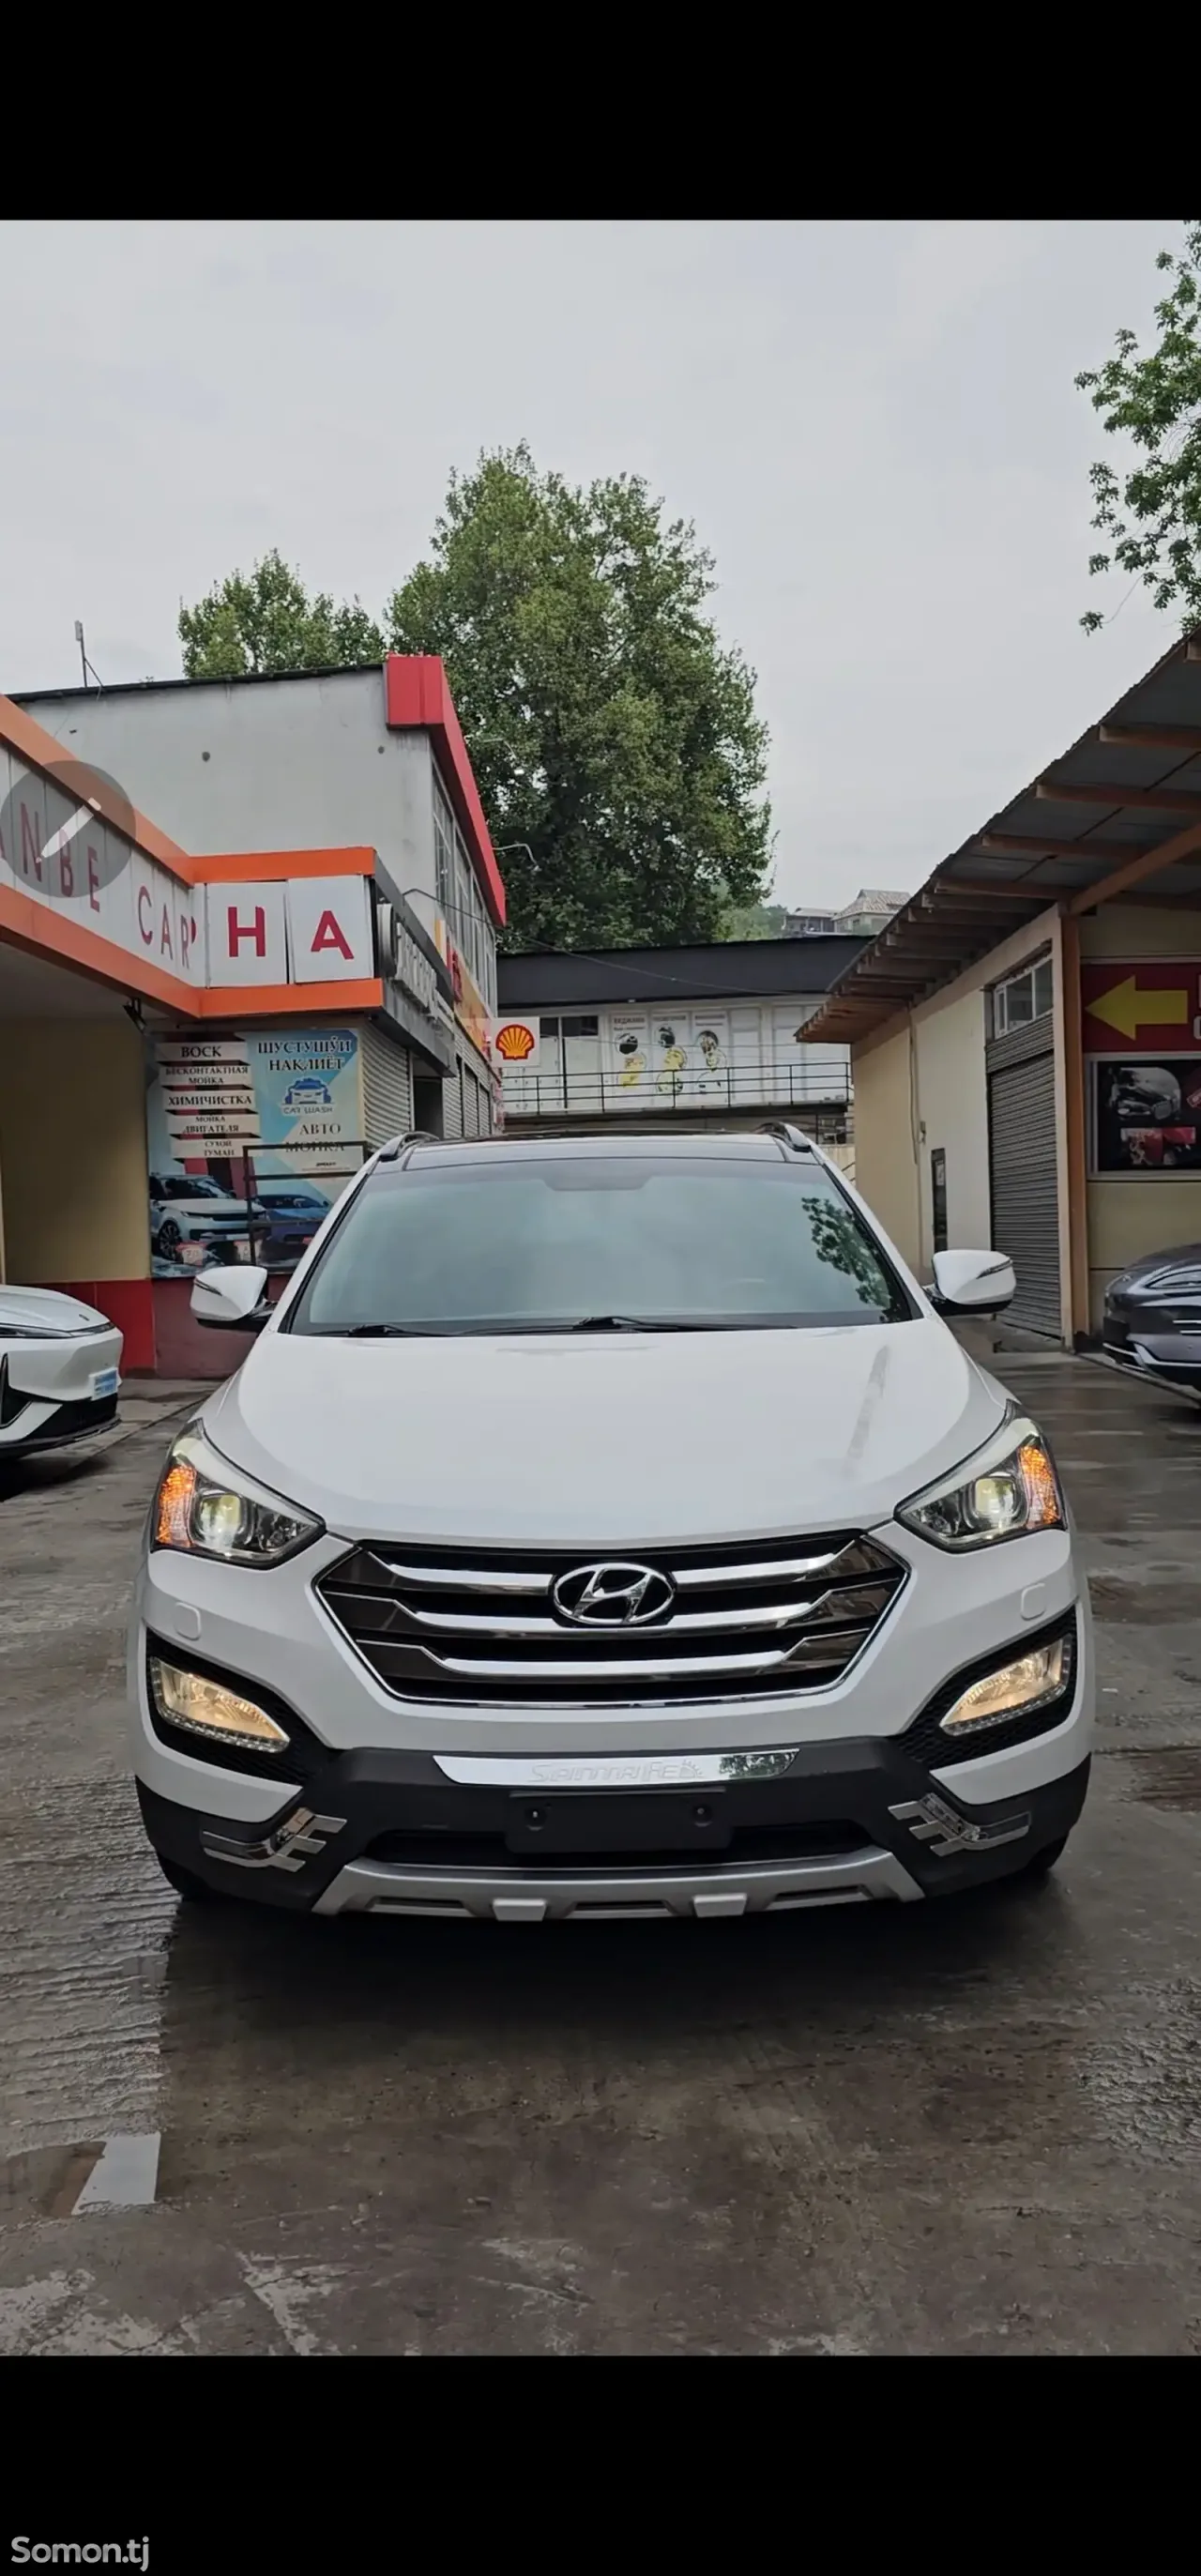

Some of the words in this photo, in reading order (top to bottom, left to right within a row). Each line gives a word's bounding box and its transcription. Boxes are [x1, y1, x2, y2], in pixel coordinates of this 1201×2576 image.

[180, 1045, 222, 1059] ВОСК
[189, 1075, 224, 1084] МОЙКА
[168, 1095, 252, 1105] ХИМИЧИСТКА
[282, 1106, 300, 1115] CAR
[195, 1114, 226, 1122] МОЙКА
[183, 1124, 239, 1134] ДВИГАТЕЛЯ
[299, 1123, 342, 1136] АВТО
